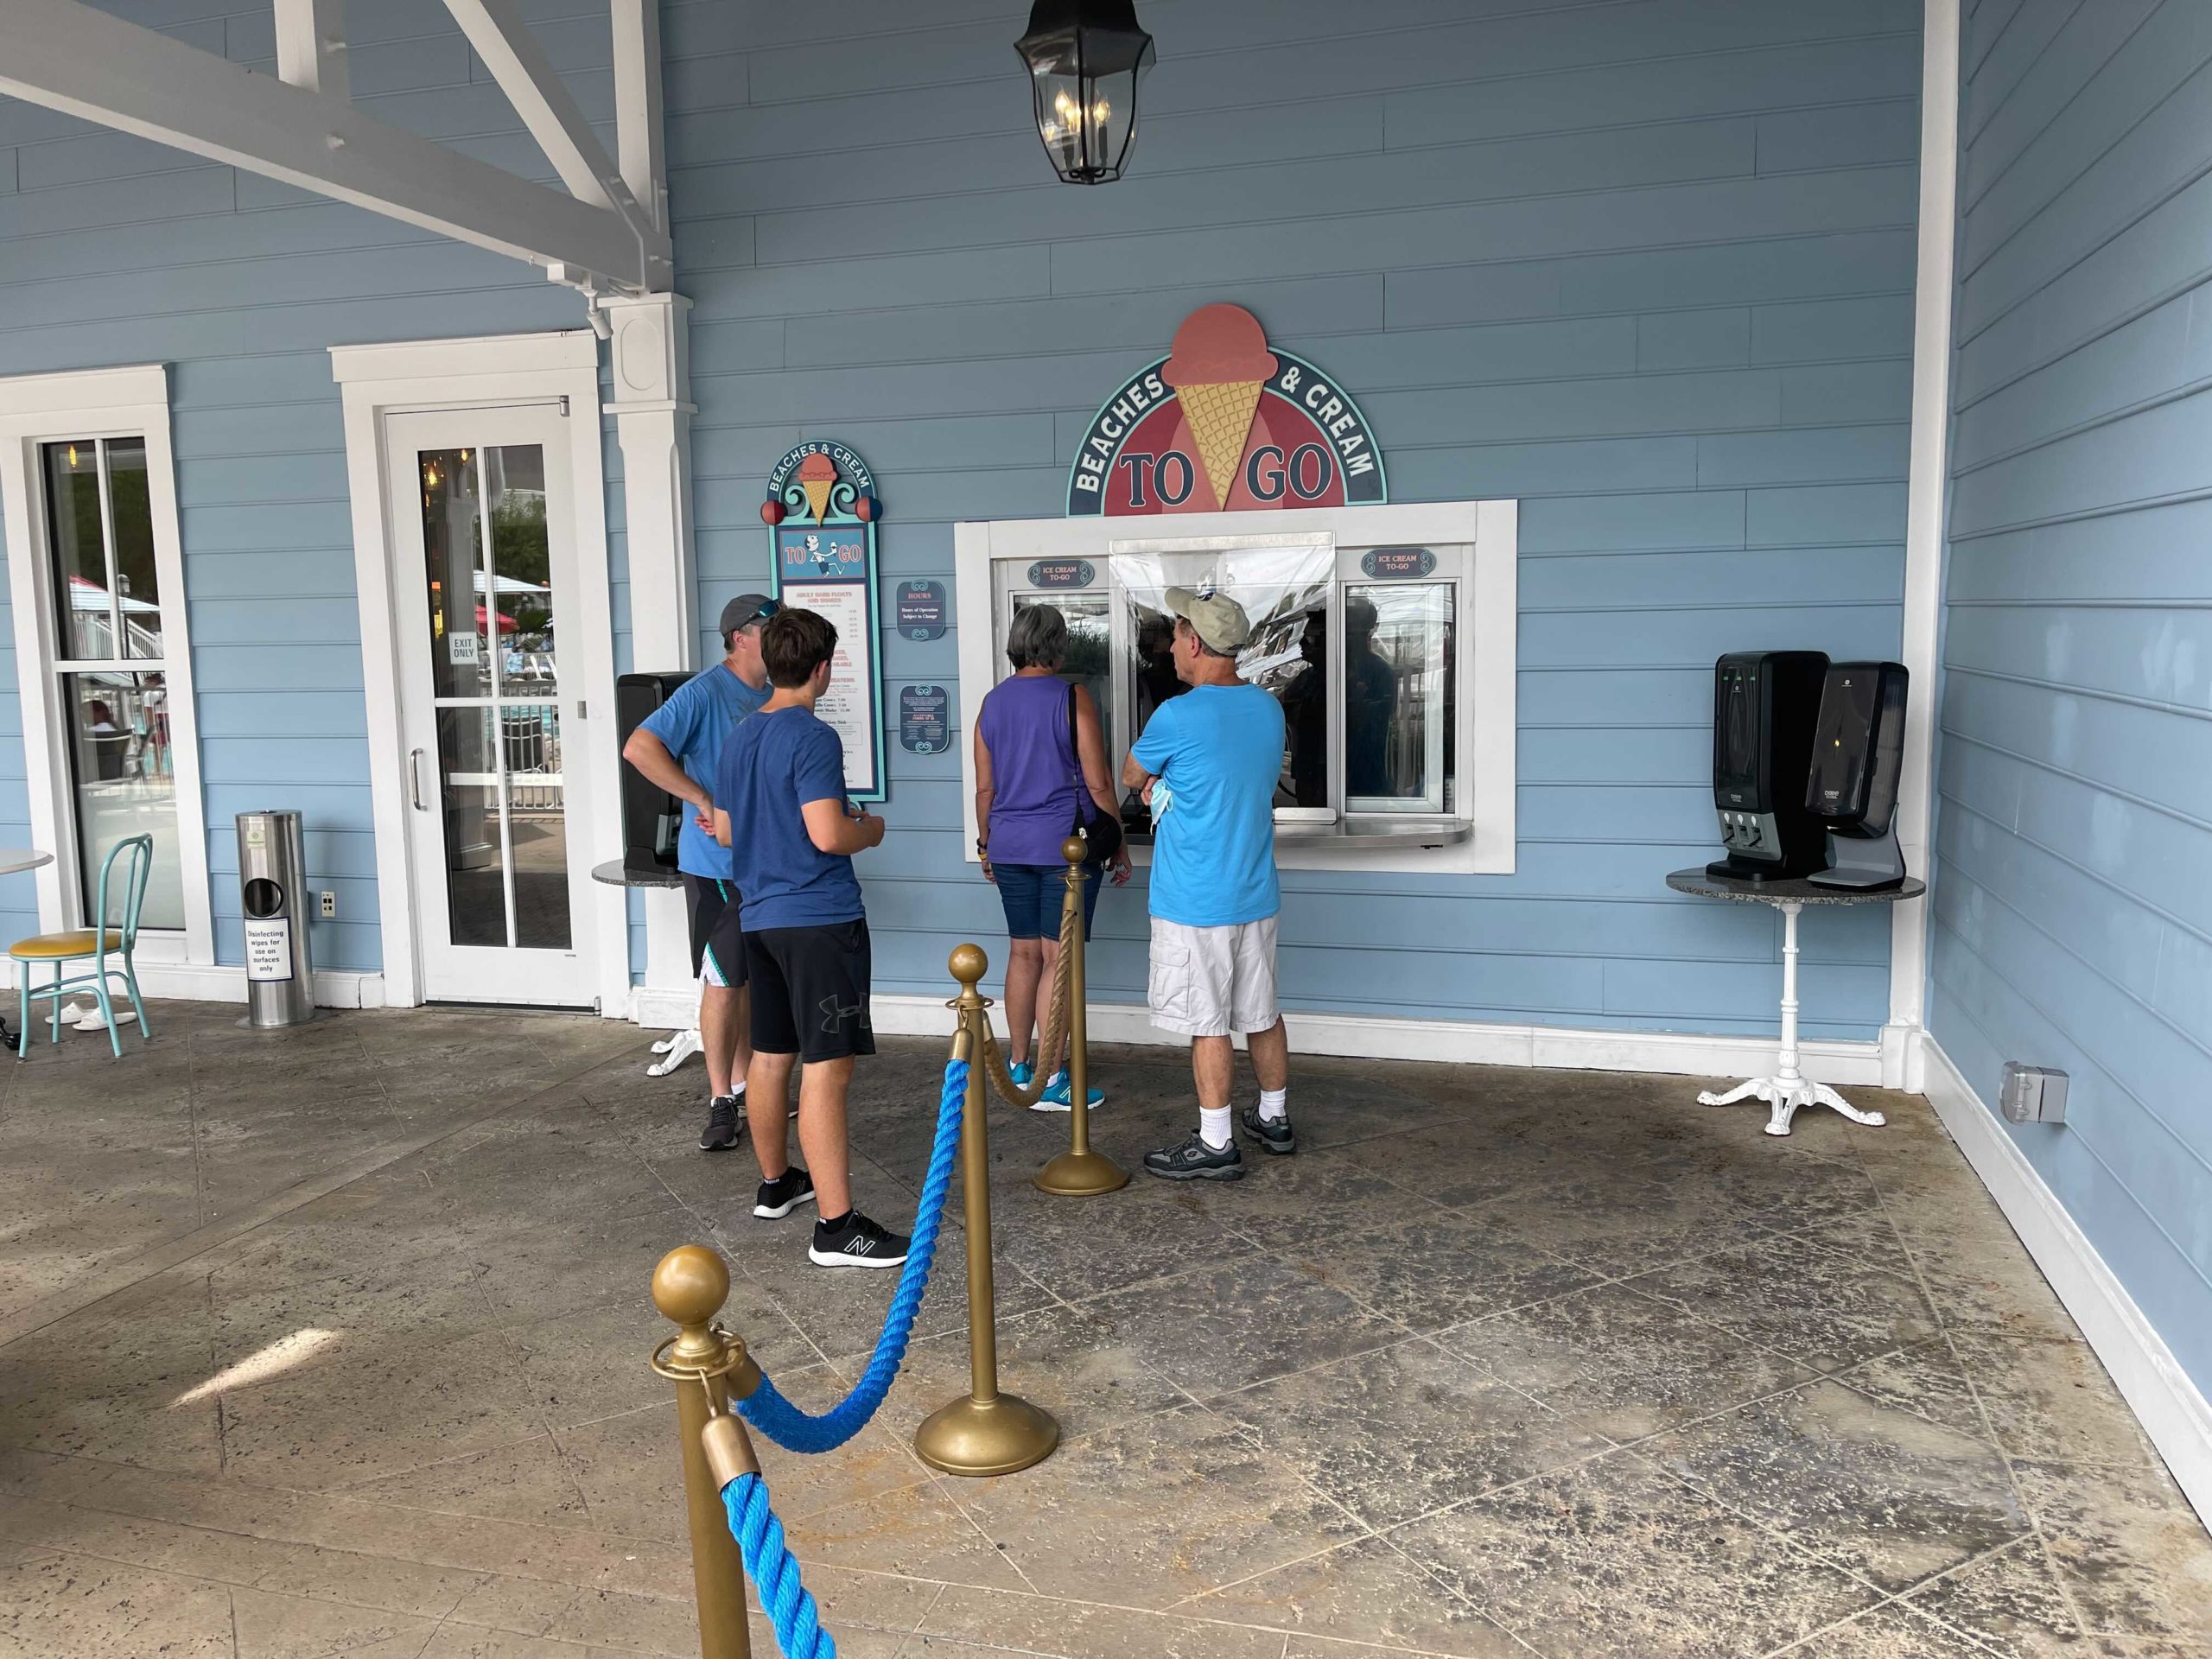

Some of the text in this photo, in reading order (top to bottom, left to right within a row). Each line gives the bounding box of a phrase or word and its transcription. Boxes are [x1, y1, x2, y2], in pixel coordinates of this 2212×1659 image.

[1077, 366, 1375, 493] BEACHES & CREAM
[770, 444, 869, 493] BEACHES & CREAM
[1120, 442, 1332, 507] TO GO
[785, 544, 861, 564] TO GO
[259, 964, 273, 973] only
[843, 1235, 876, 1257] N
